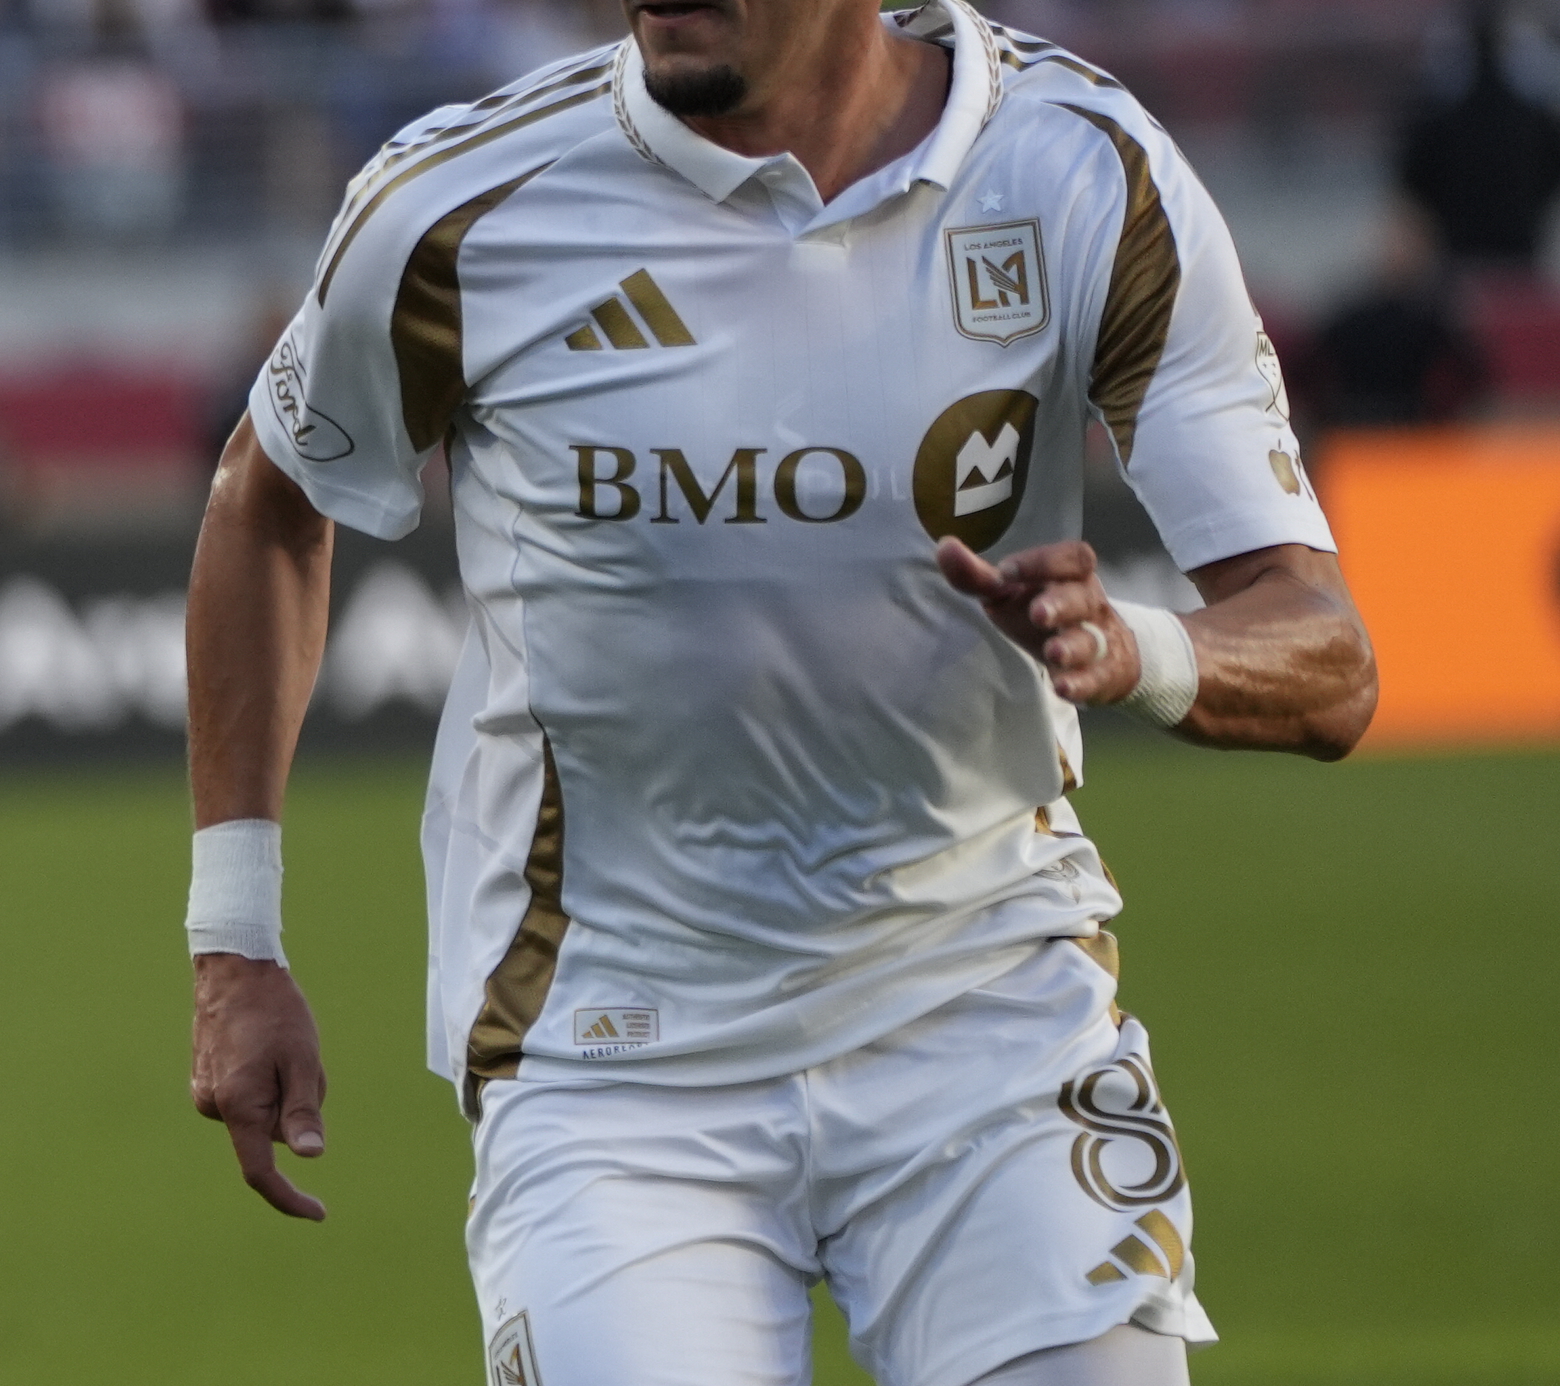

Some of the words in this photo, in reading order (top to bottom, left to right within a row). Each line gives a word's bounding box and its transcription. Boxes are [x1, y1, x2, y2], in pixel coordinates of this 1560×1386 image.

[964, 243, 982, 251] LOS
[983, 238, 1023, 249] ANGELES
[972, 314, 1011, 323] FOOTBALL
[271, 341, 317, 446] Ford
[569, 444, 867, 525] BMO
[1058, 1052, 1187, 1213] 8
